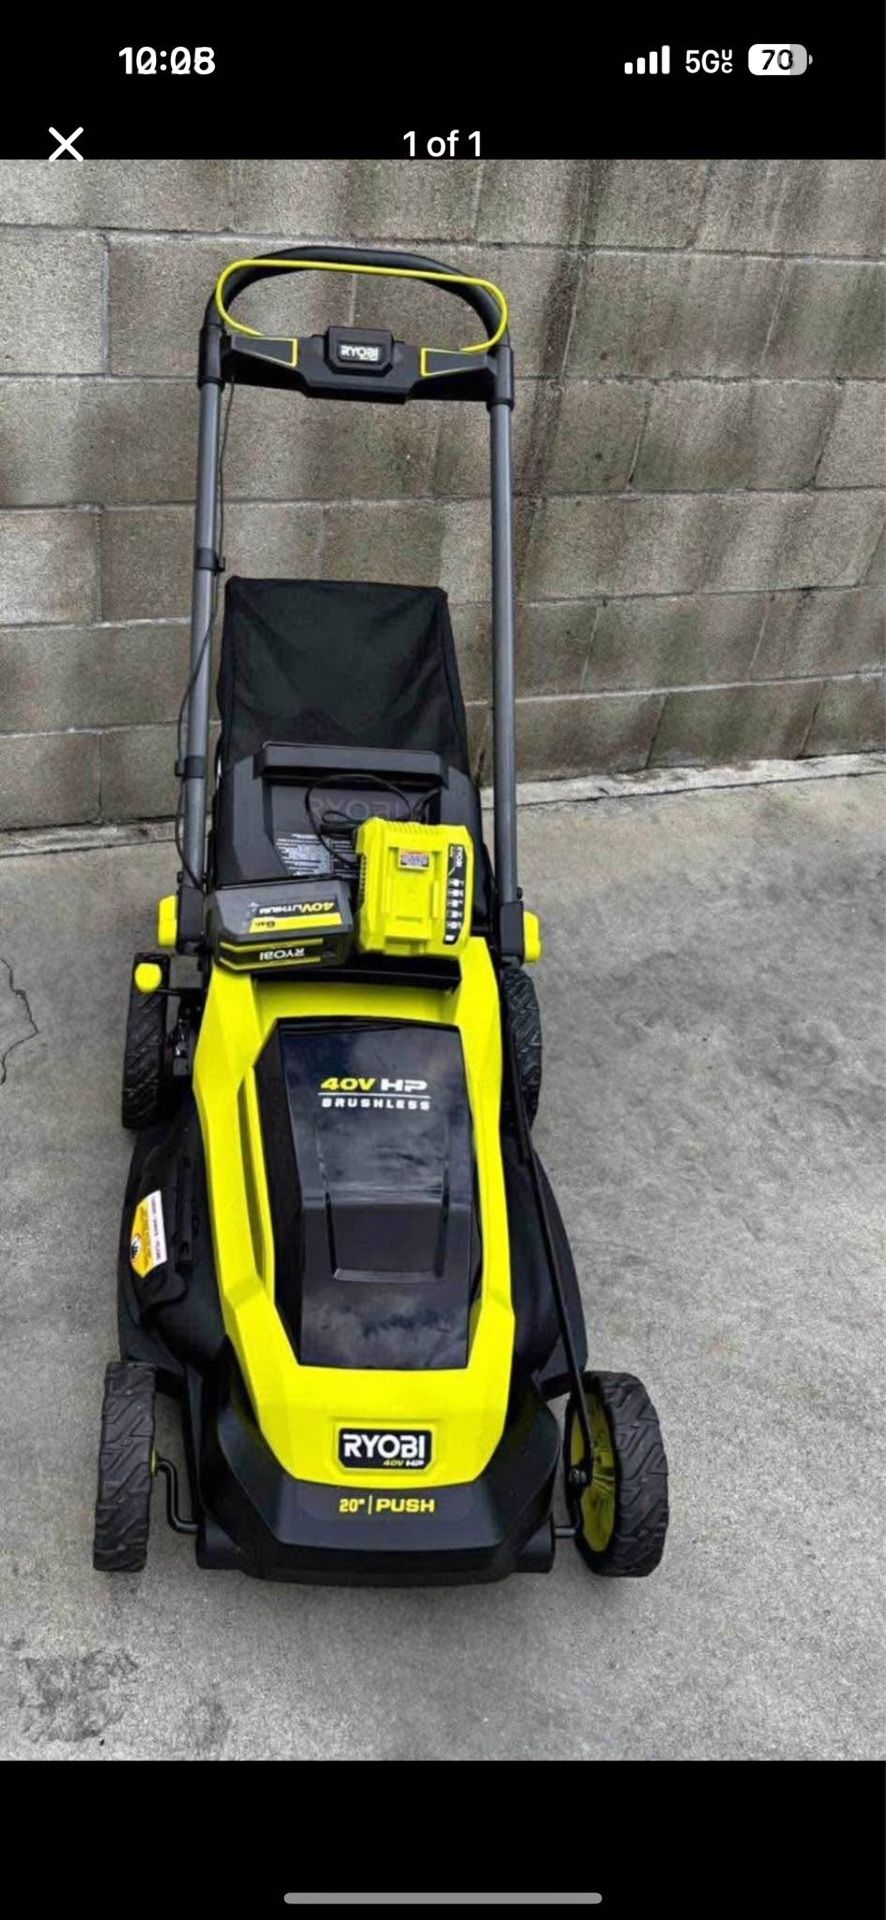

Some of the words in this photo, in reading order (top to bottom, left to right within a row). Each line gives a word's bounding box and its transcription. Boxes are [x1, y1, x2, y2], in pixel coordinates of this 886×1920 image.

[340, 345, 379, 359] RYOBI
[259, 948, 305, 961] RYOBI
[320, 1077, 376, 1091] 40V
[381, 1078, 428, 1092] HP
[321, 1097, 431, 1111] BRUSHLESS
[342, 1433, 426, 1459] RYOBI
[382, 1459, 404, 1467] 40V
[405, 1459, 425, 1467] HP
[375, 1498, 436, 1513] PUSH
